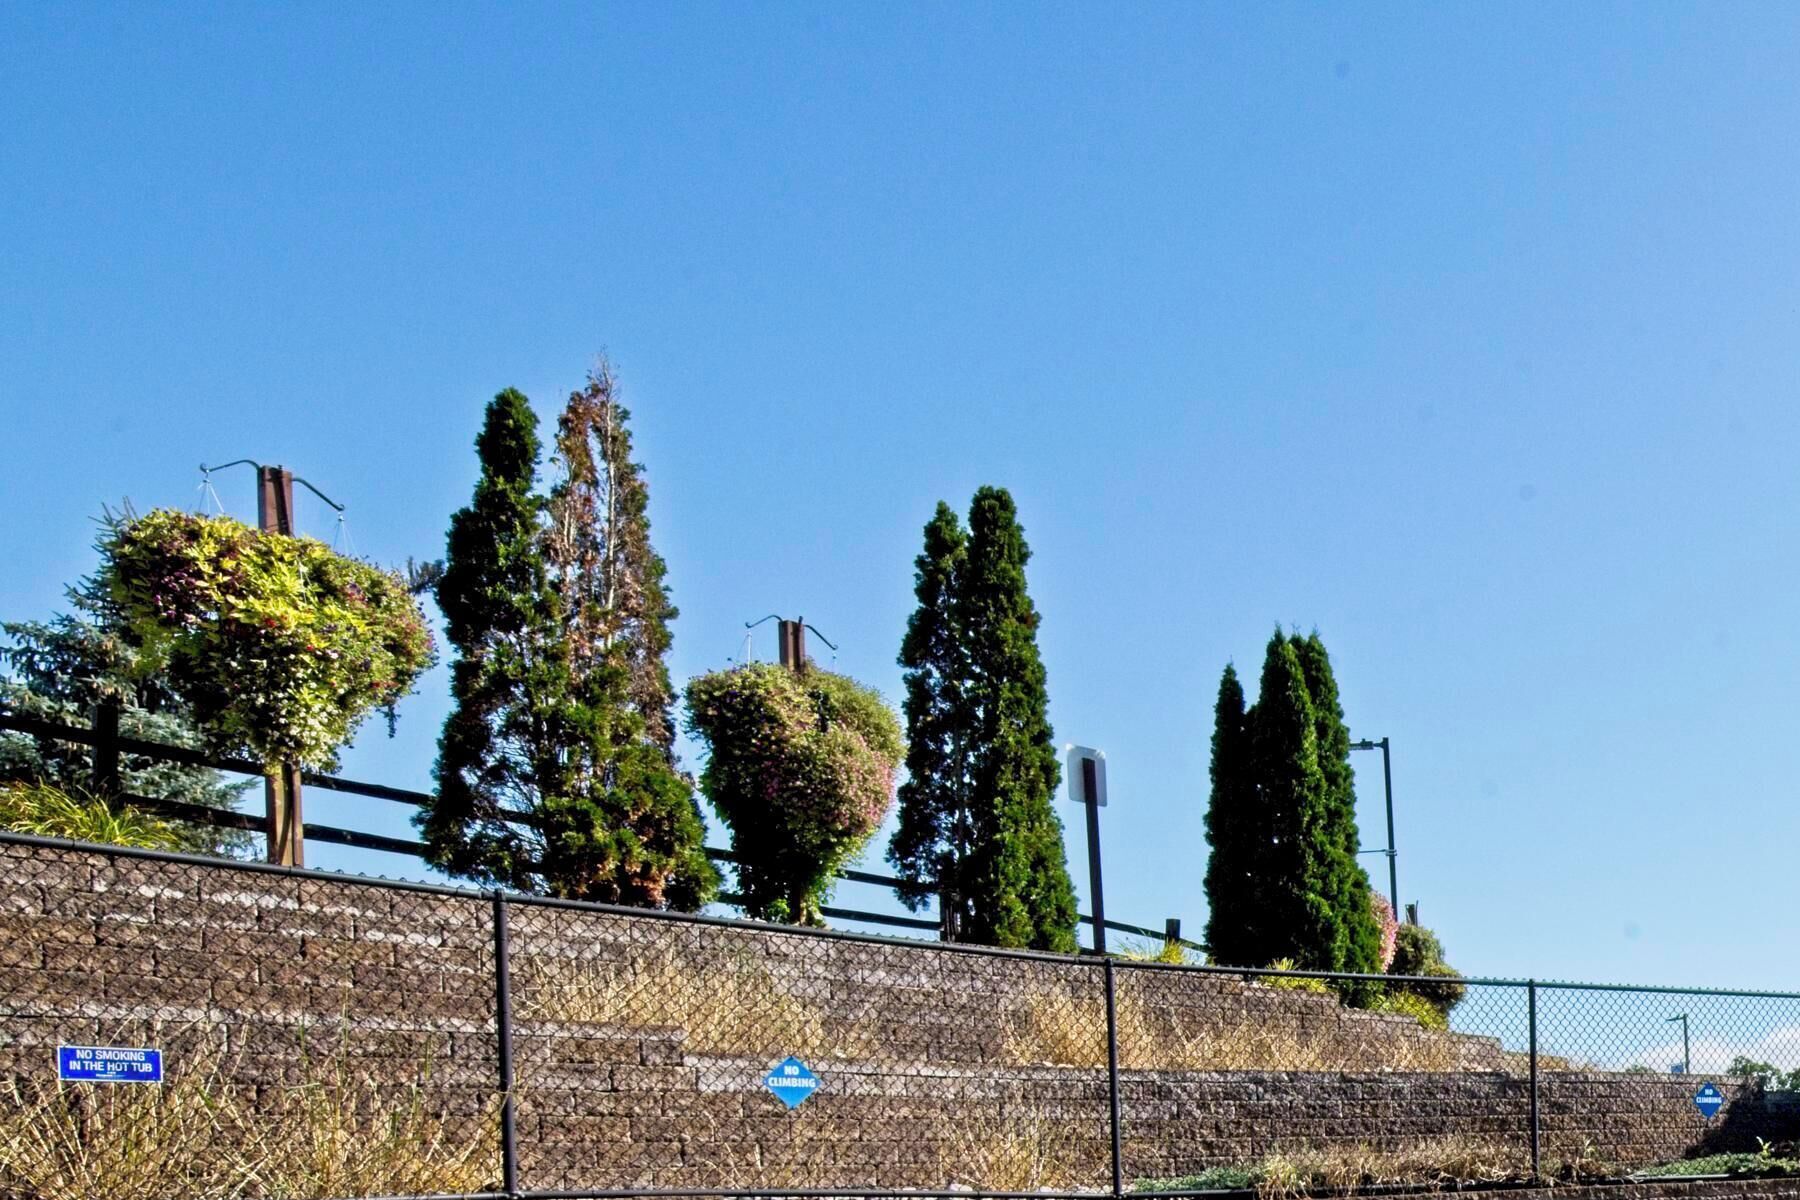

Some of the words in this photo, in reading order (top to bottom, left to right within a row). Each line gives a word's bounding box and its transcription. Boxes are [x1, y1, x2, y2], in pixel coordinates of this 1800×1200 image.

[76, 1049, 92, 1059] NO
[95, 1050, 145, 1061] SMOKING
[69, 1060, 80, 1070] IN
[83, 1061, 104, 1071] THE
[107, 1062, 129, 1072] HOT
[131, 1062, 153, 1072] TUB
[784, 1065, 800, 1075] NO
[768, 1077, 816, 1088] CLIMBING
